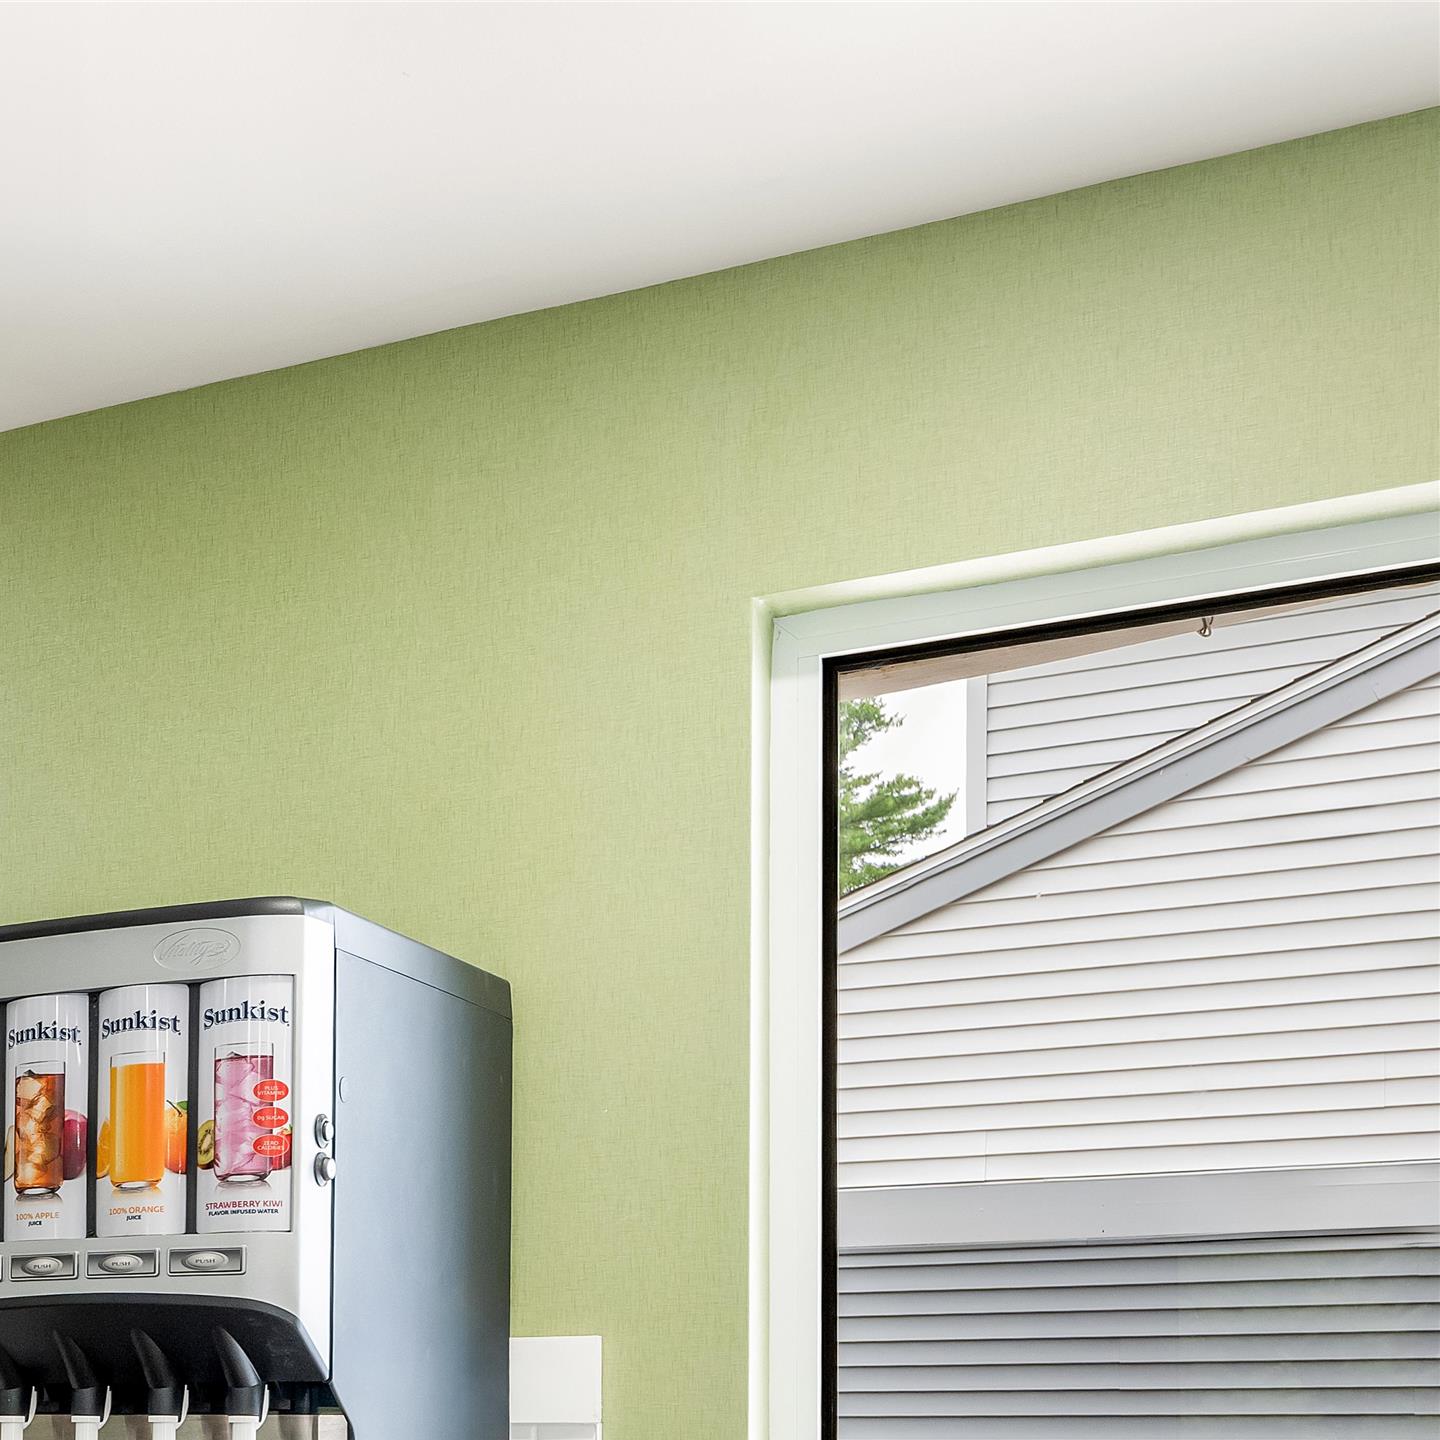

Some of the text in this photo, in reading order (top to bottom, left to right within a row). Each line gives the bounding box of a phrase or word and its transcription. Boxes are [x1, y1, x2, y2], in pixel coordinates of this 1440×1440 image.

[203, 999, 290, 1030] Sunkist
[101, 1009, 182, 1040] Sunkist
[8, 1020, 82, 1050] Sunkist
[205, 1199, 283, 1210] STRAWBERRY KIWI
[15, 1211, 60, 1221] 100% APPLE
[109, 1205, 166, 1216] 100% ORANGE
[208, 1209, 229, 1217] FLAVOR
[126, 1213, 142, 1221] JUICE
